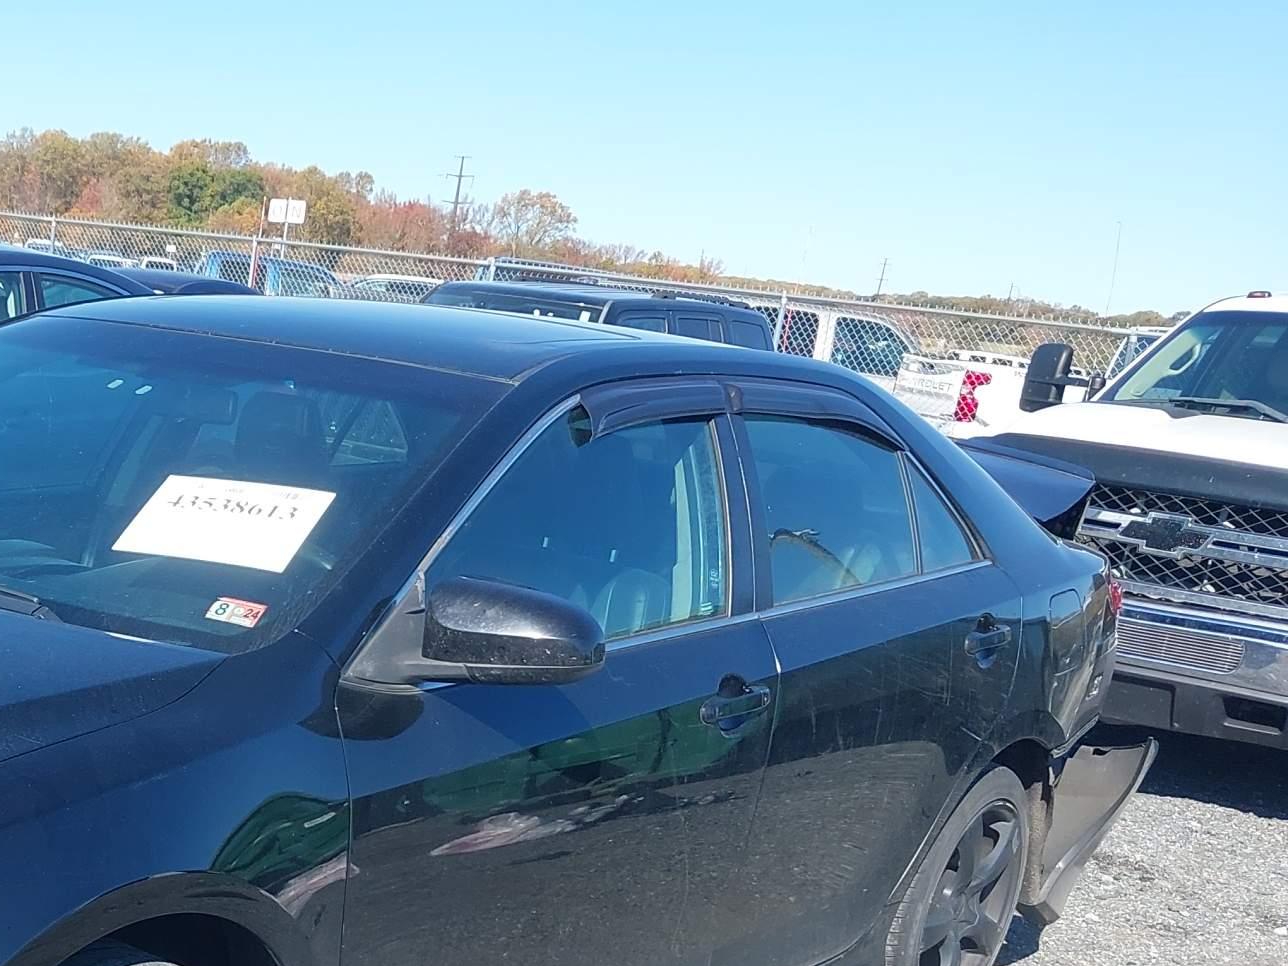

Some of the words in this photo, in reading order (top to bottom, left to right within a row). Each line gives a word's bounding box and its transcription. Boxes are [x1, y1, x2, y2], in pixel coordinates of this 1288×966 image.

[168, 494, 299, 520] 43538613
[215, 602, 230, 616] 8
[242, 607, 261, 621] 24
